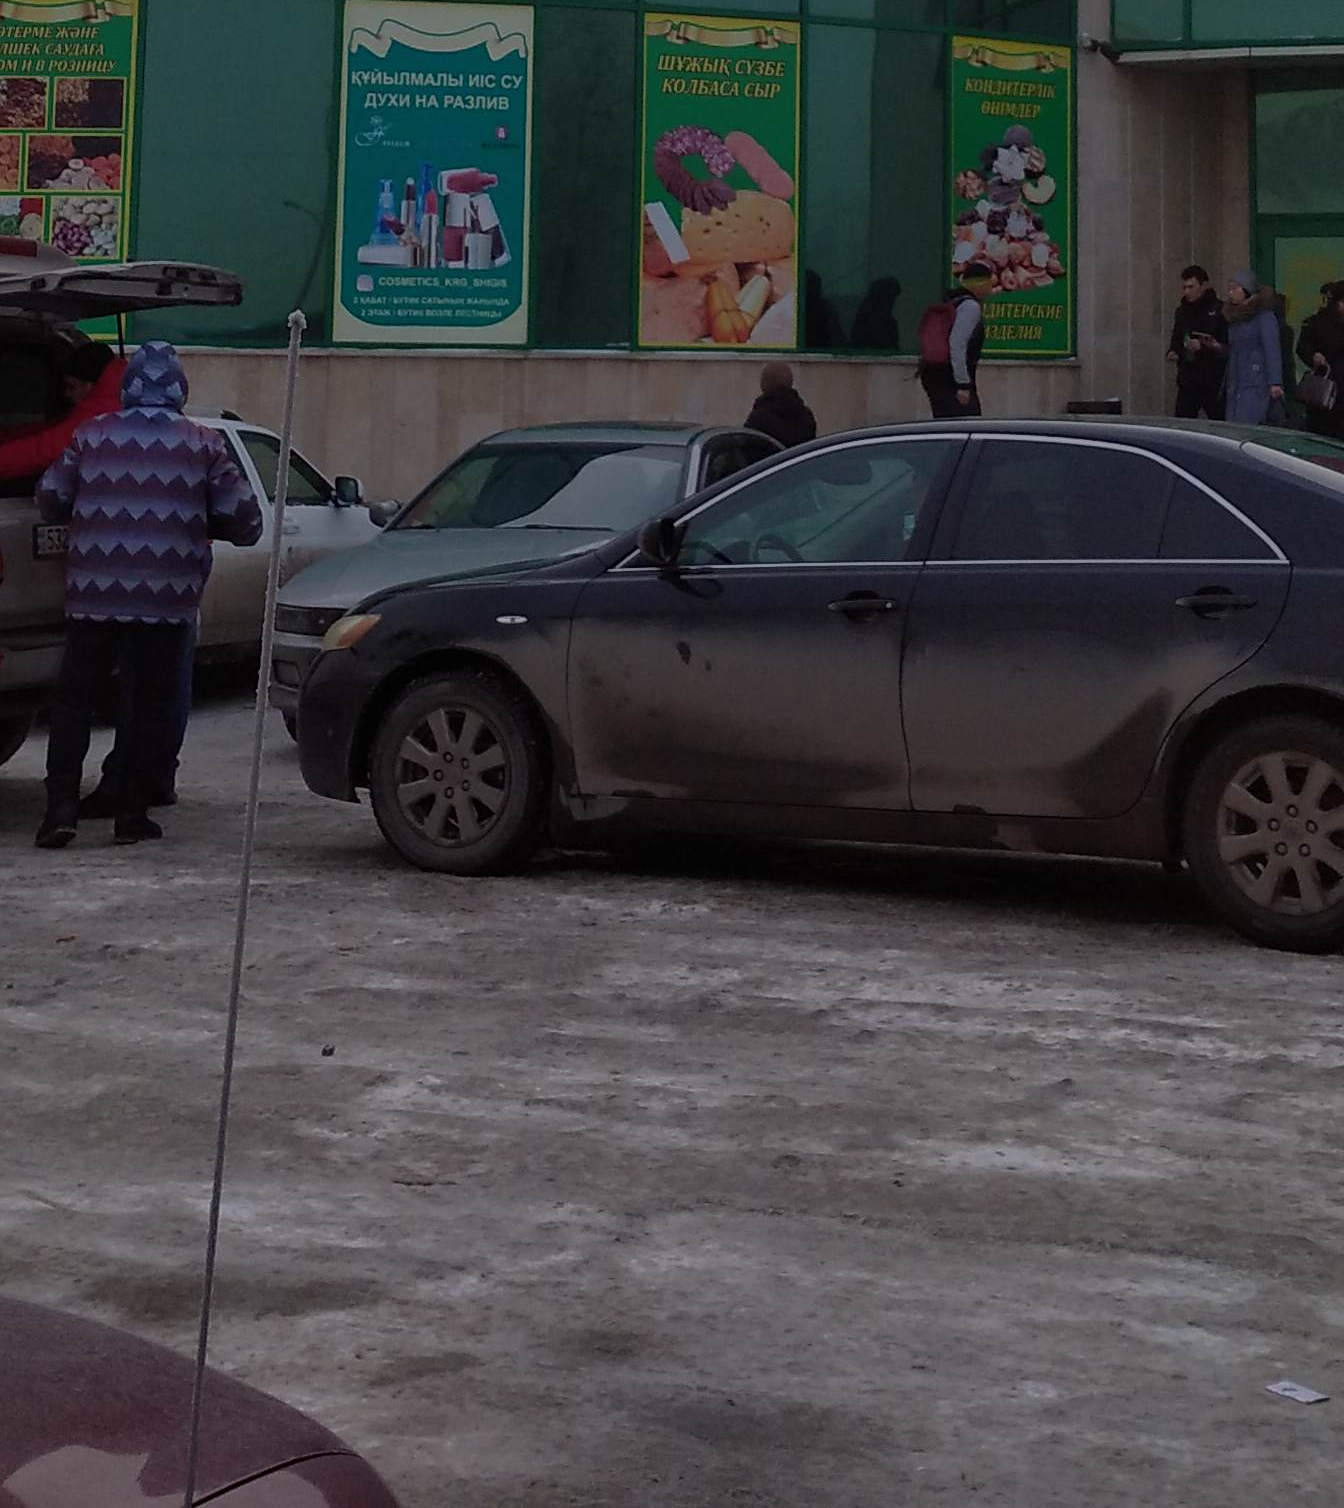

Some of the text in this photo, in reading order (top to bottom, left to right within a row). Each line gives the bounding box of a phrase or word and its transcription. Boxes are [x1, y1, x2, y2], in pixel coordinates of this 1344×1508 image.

[55, 27, 99, 39] ЖӘНЕ
[22, 59, 32, 71] И
[36, 59, 45, 71] В
[48, 59, 117, 73] РОЗНИЦУ
[735, 58, 786, 77] СҮЗБЕ
[468, 73, 498, 90] ИІС
[501, 75, 523, 91] СУ
[662, 78, 781, 99] КОЛБАСА СЫР
[364, 92, 510, 112] ДУХИ НА РАЗЛИВ
